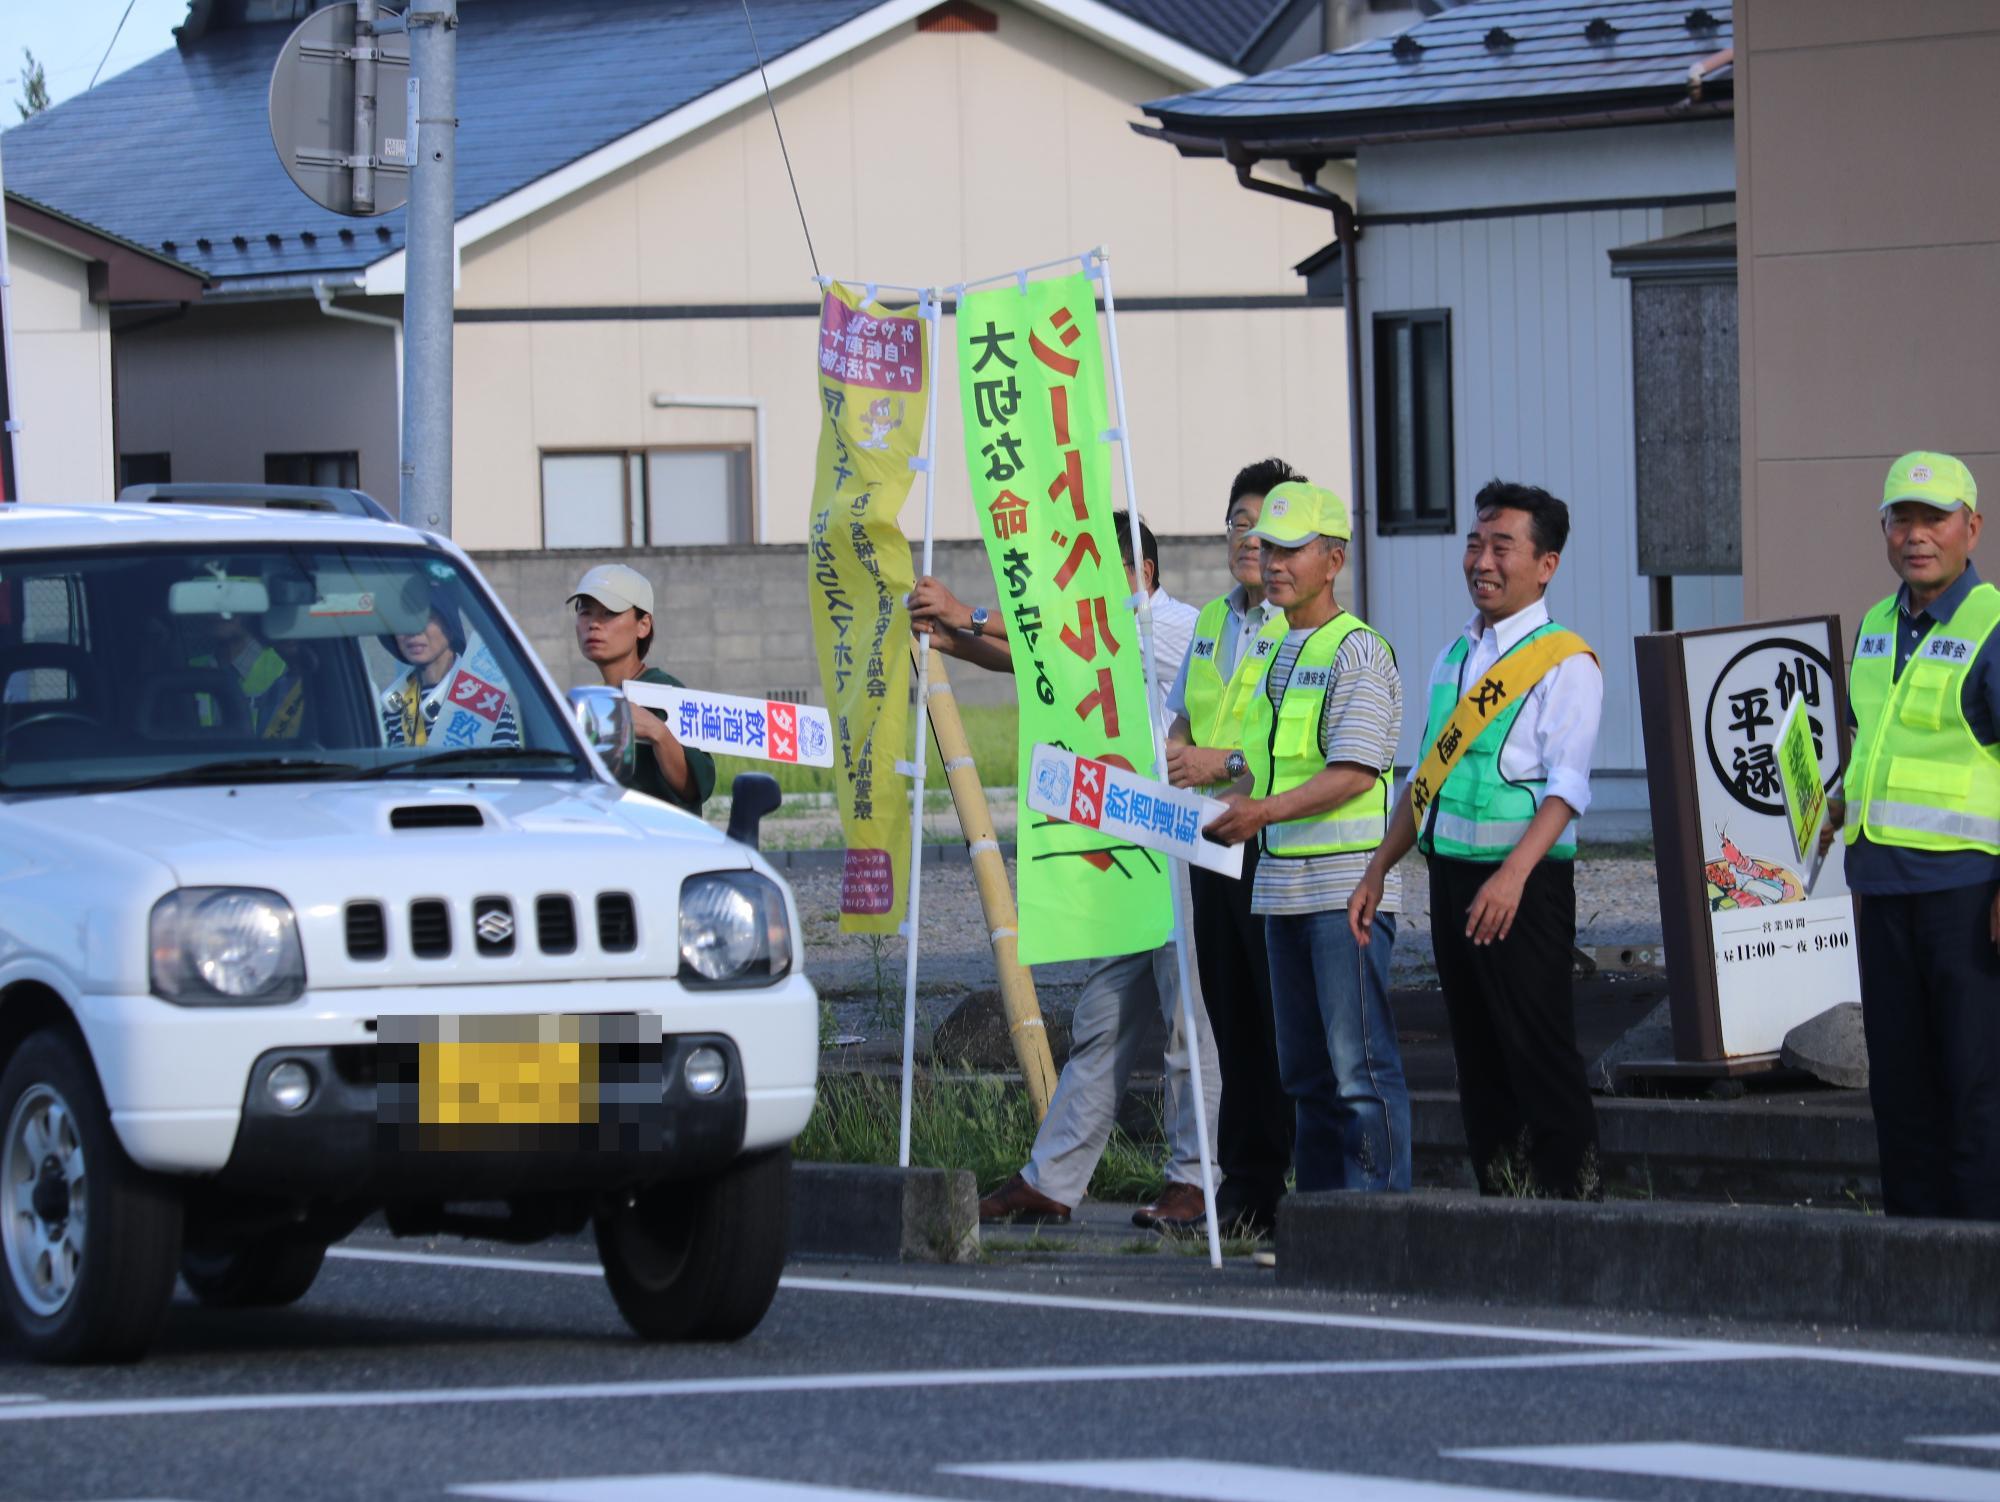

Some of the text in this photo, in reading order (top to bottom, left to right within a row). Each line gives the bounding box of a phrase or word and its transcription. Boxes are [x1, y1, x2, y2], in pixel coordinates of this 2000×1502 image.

[1861, 638, 1886, 654] 加美
[455, 679, 500, 712] ダメ
[678, 699, 766, 748] 飲酒運転
[771, 708, 794, 757] ダメ
[1073, 763, 1102, 821] ダメ
[1104, 783, 1200, 846] 飲酒運転
[1762, 917, 1806, 933] 営業時間
